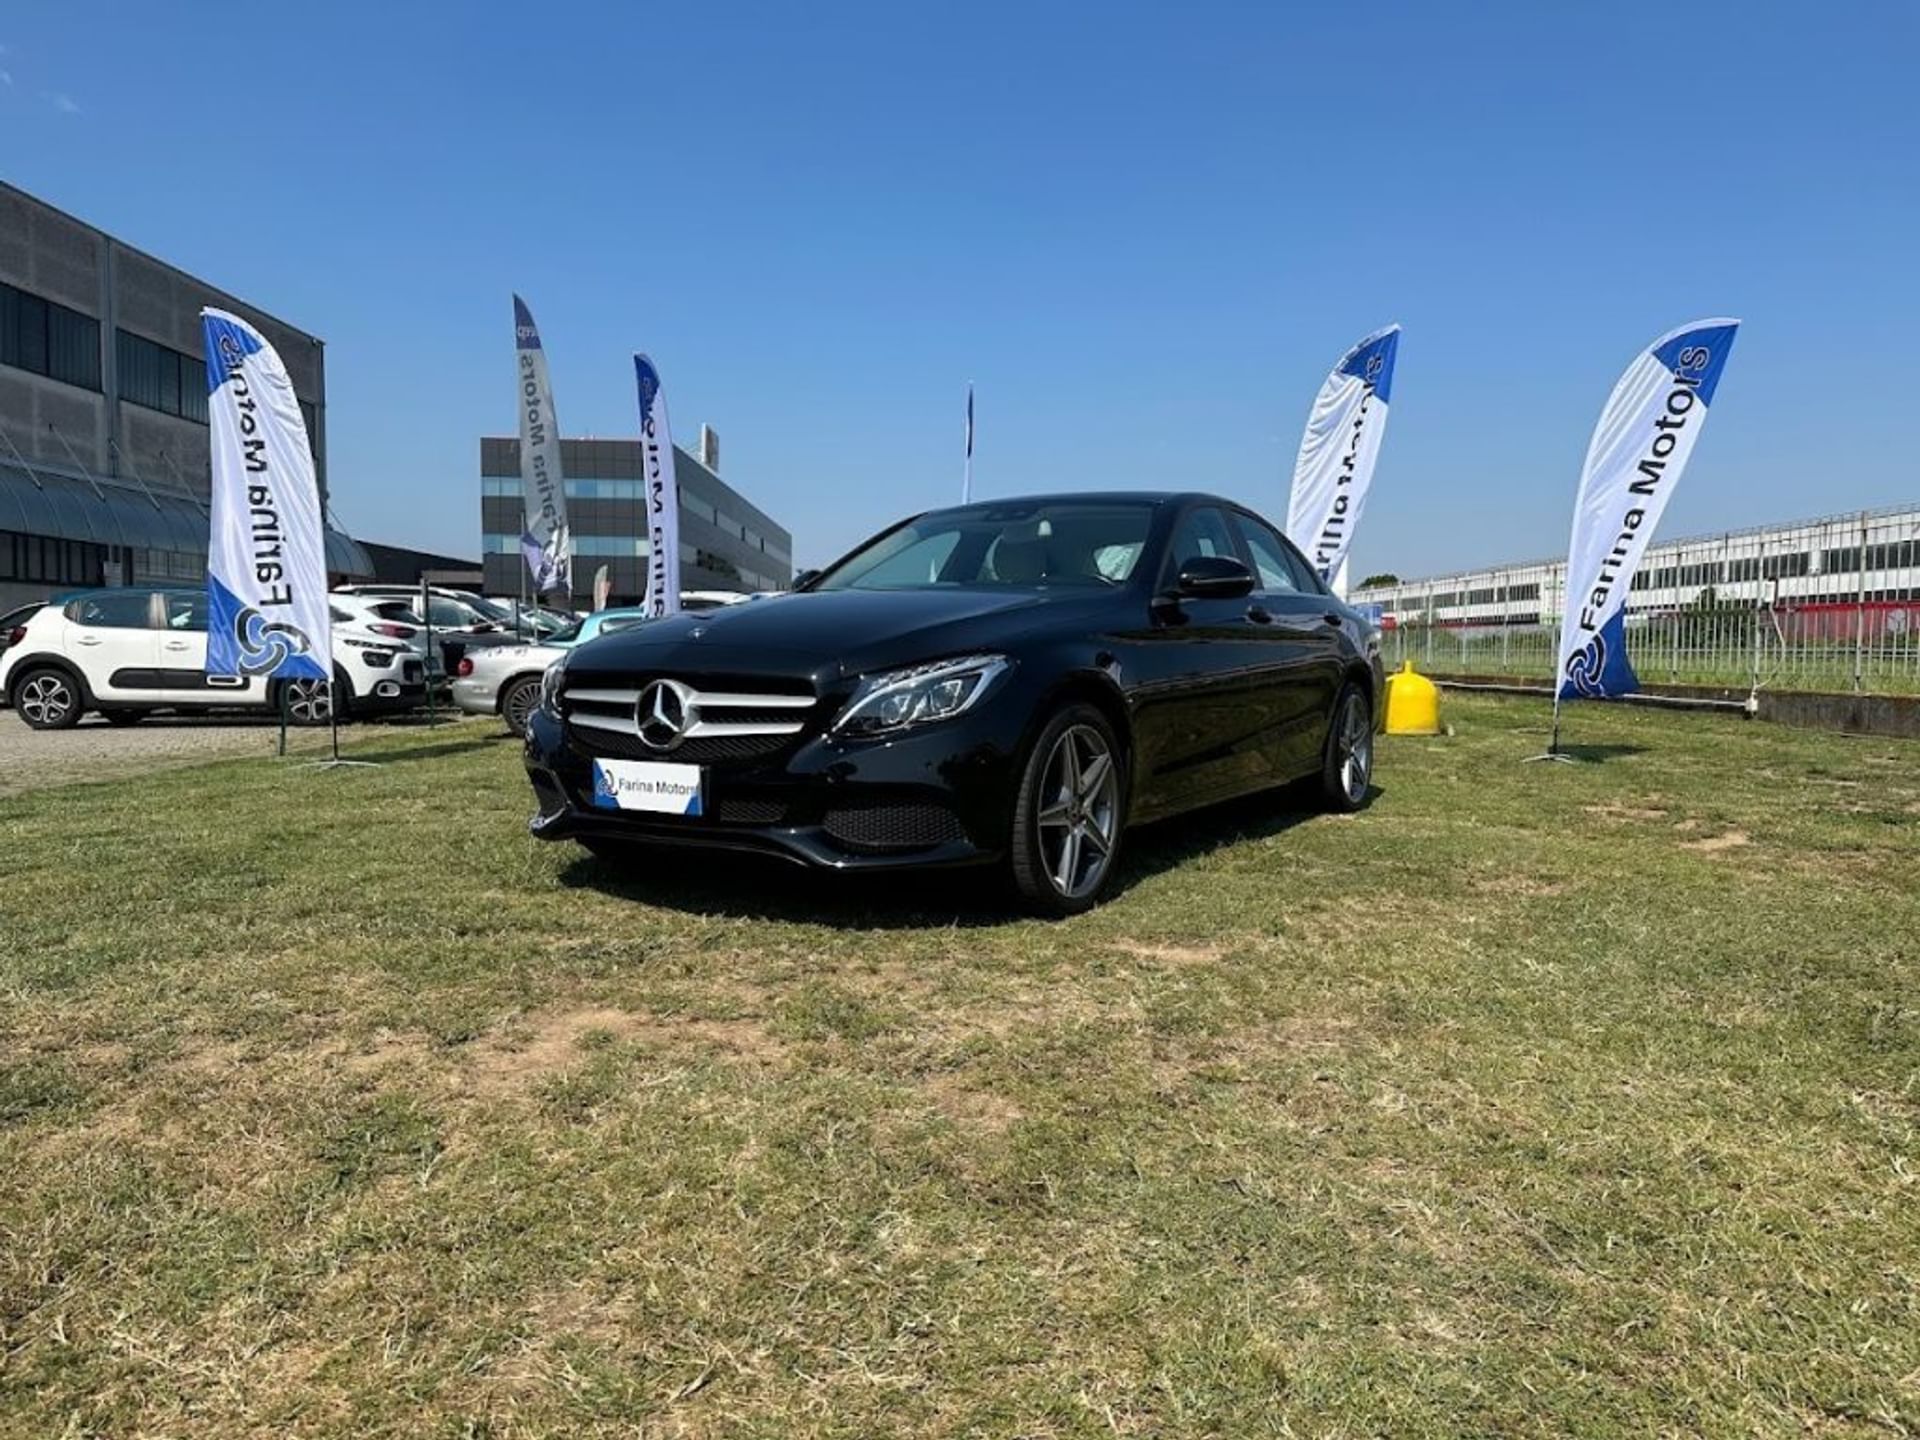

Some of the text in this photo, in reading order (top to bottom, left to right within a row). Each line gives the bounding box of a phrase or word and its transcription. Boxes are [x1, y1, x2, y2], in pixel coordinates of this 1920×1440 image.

[1579, 346, 1711, 632] Farina Motors
[1316, 495, 1349, 582] arina
[618, 778, 654, 793] Farina
